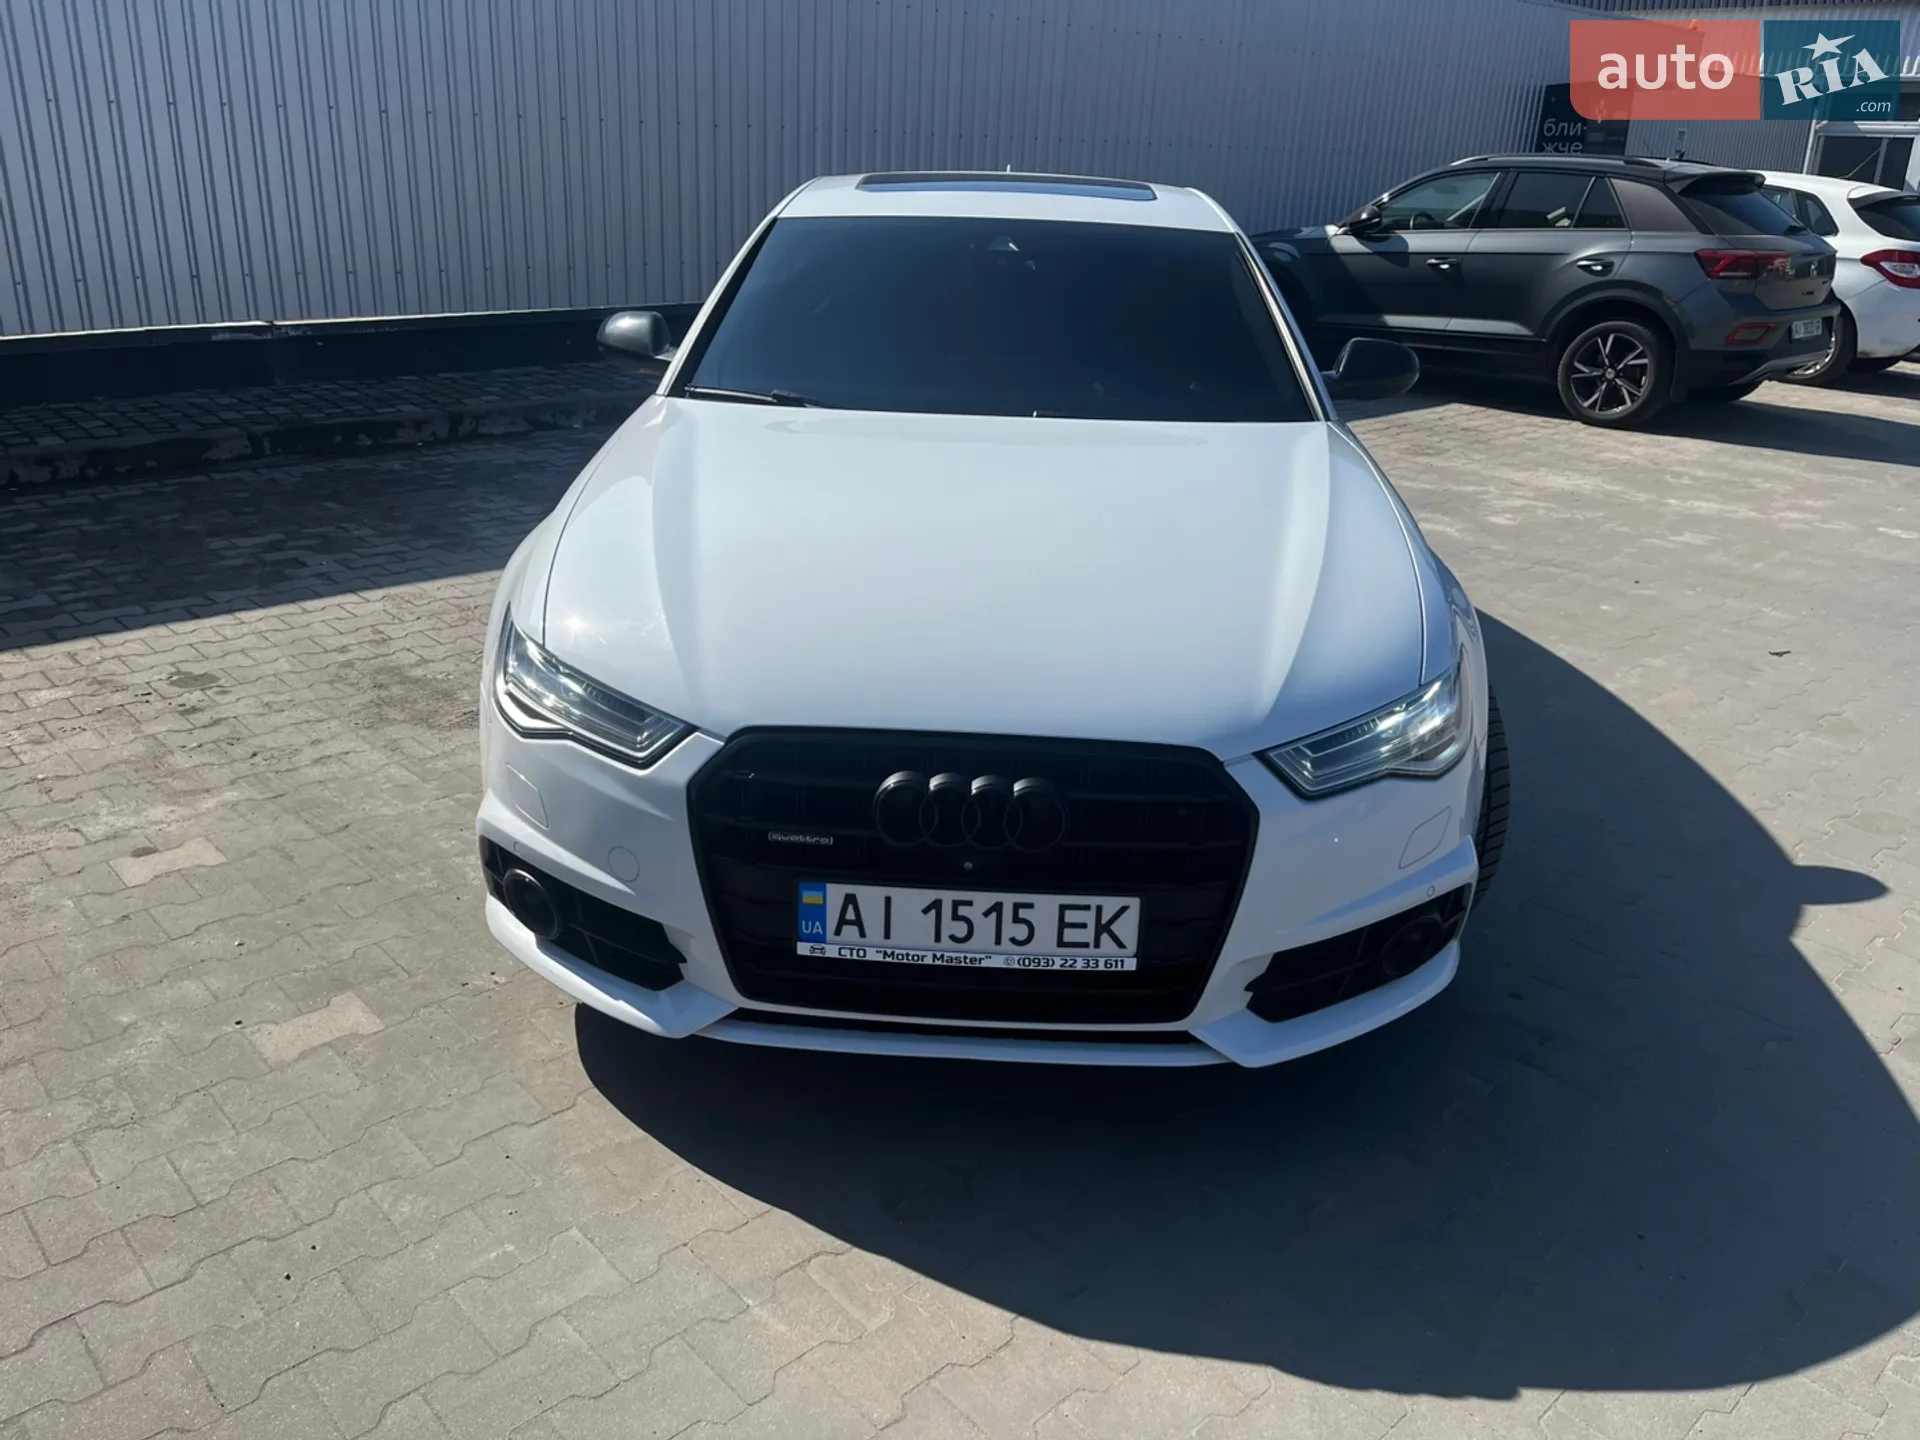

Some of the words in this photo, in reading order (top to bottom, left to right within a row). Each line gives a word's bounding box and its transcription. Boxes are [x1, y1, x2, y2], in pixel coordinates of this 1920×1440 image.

[770, 832, 831, 845] quattro
[802, 920, 823, 934] UA
[833, 893, 892, 940] AI
[921, 898, 1035, 947] 1515
[1056, 903, 1131, 949] EK
[875, 950, 927, 963] "Motor
[932, 953, 992, 965] Master"
[1017, 957, 1055, 968] (093)
[1059, 958, 1077, 968] 22
[1081, 959, 1099, 969] 33
[1104, 959, 1125, 969] 611
